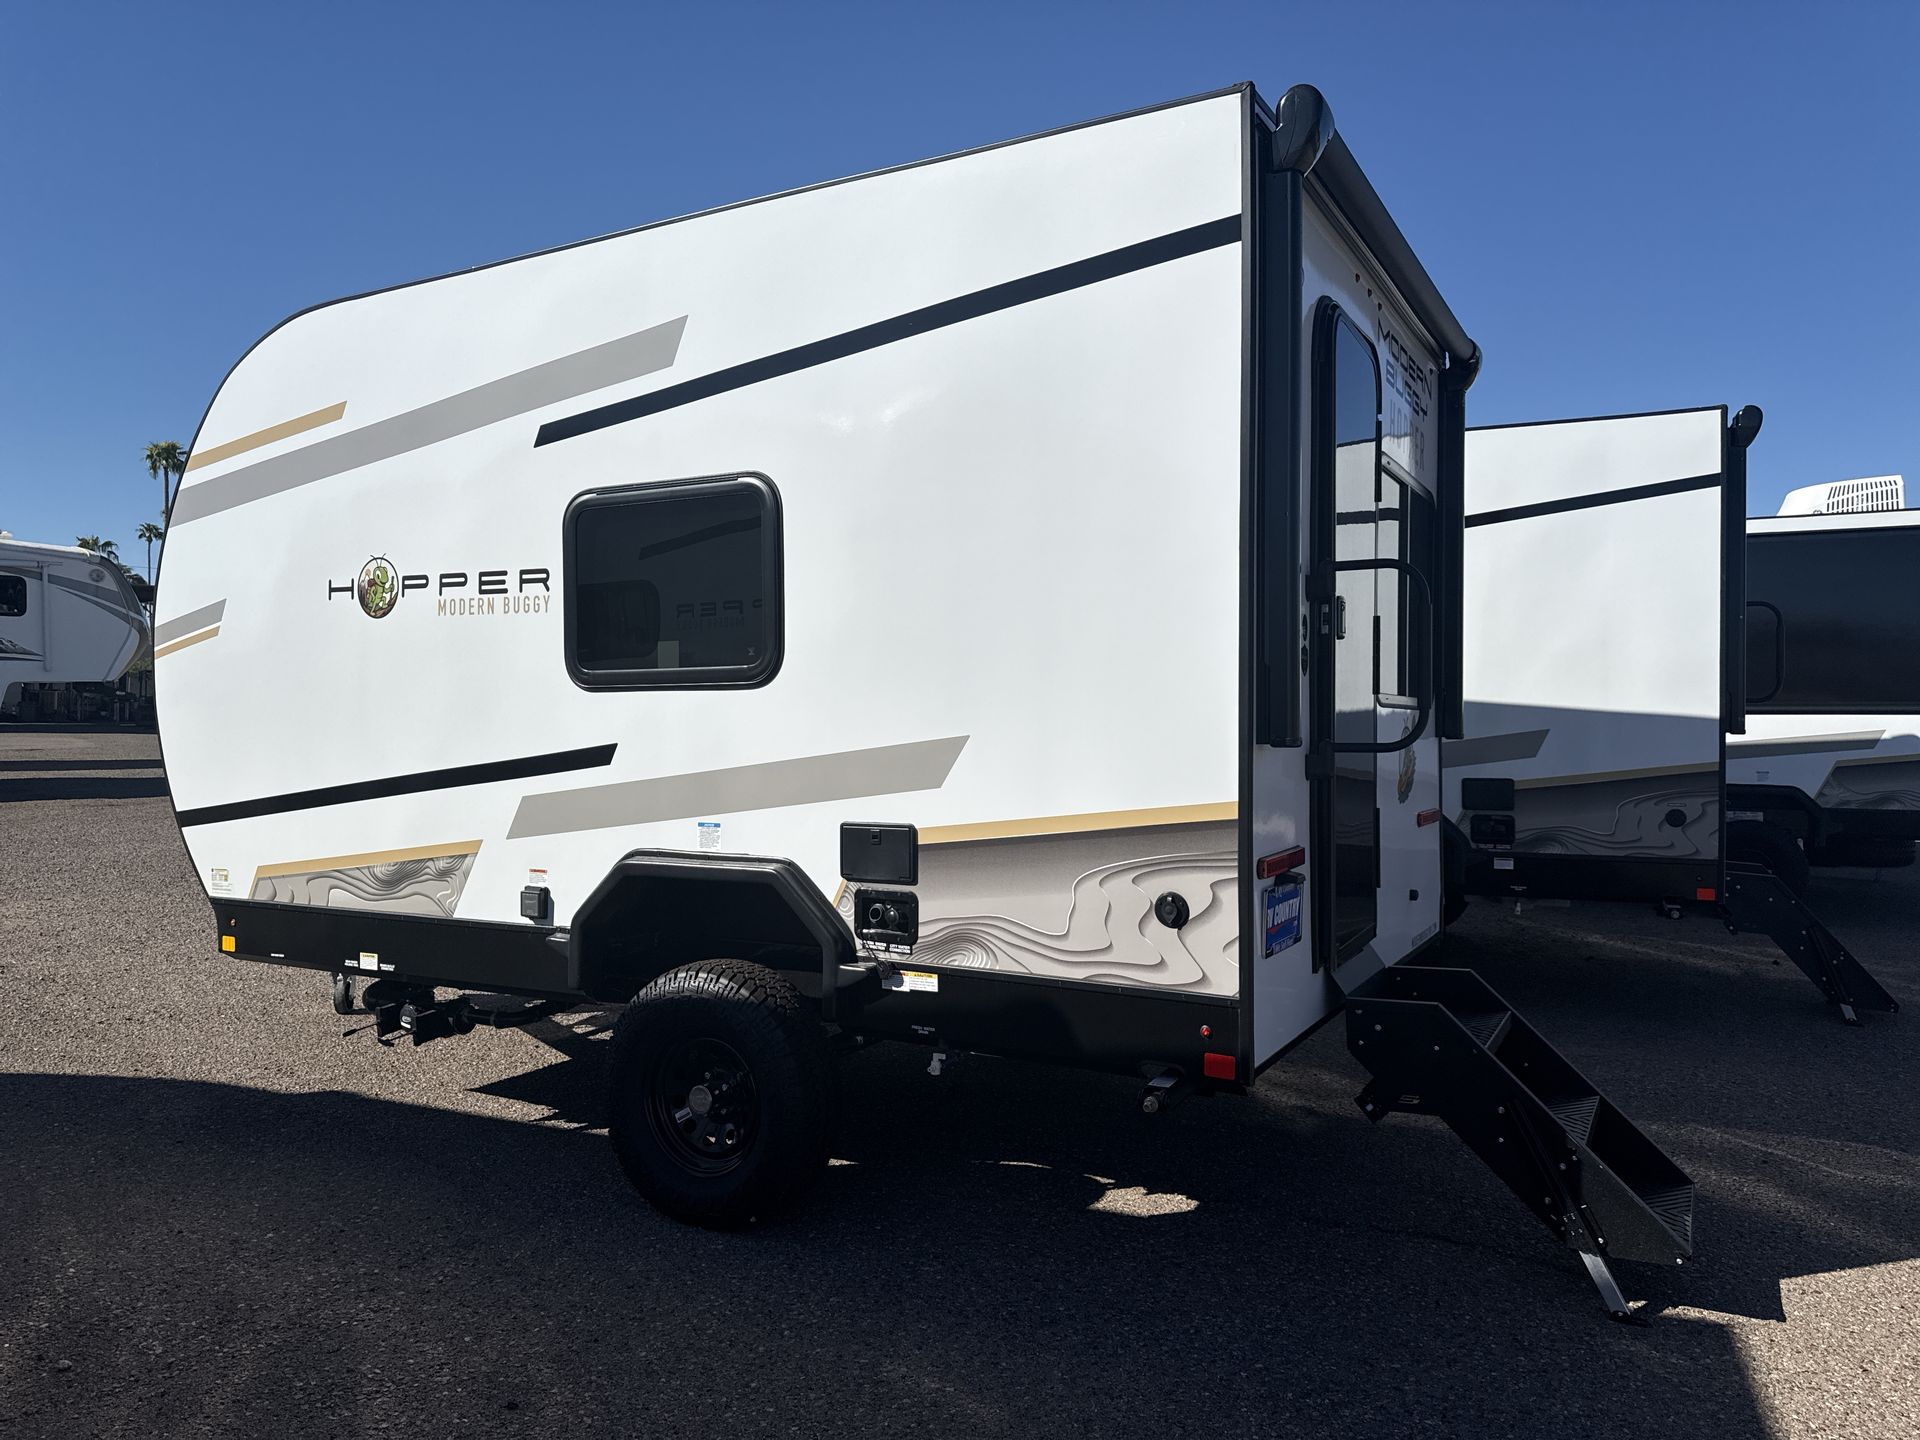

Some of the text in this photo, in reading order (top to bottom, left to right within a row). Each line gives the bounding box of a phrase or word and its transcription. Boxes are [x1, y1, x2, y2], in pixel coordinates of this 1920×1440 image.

[1377, 317, 1433, 401] MODERN
[1385, 358, 1428, 423] BUGGY
[1389, 398, 1425, 473] HOPPER
[328, 557, 551, 618] HOPPER
[436, 593, 551, 617] MODERN BUGGY
